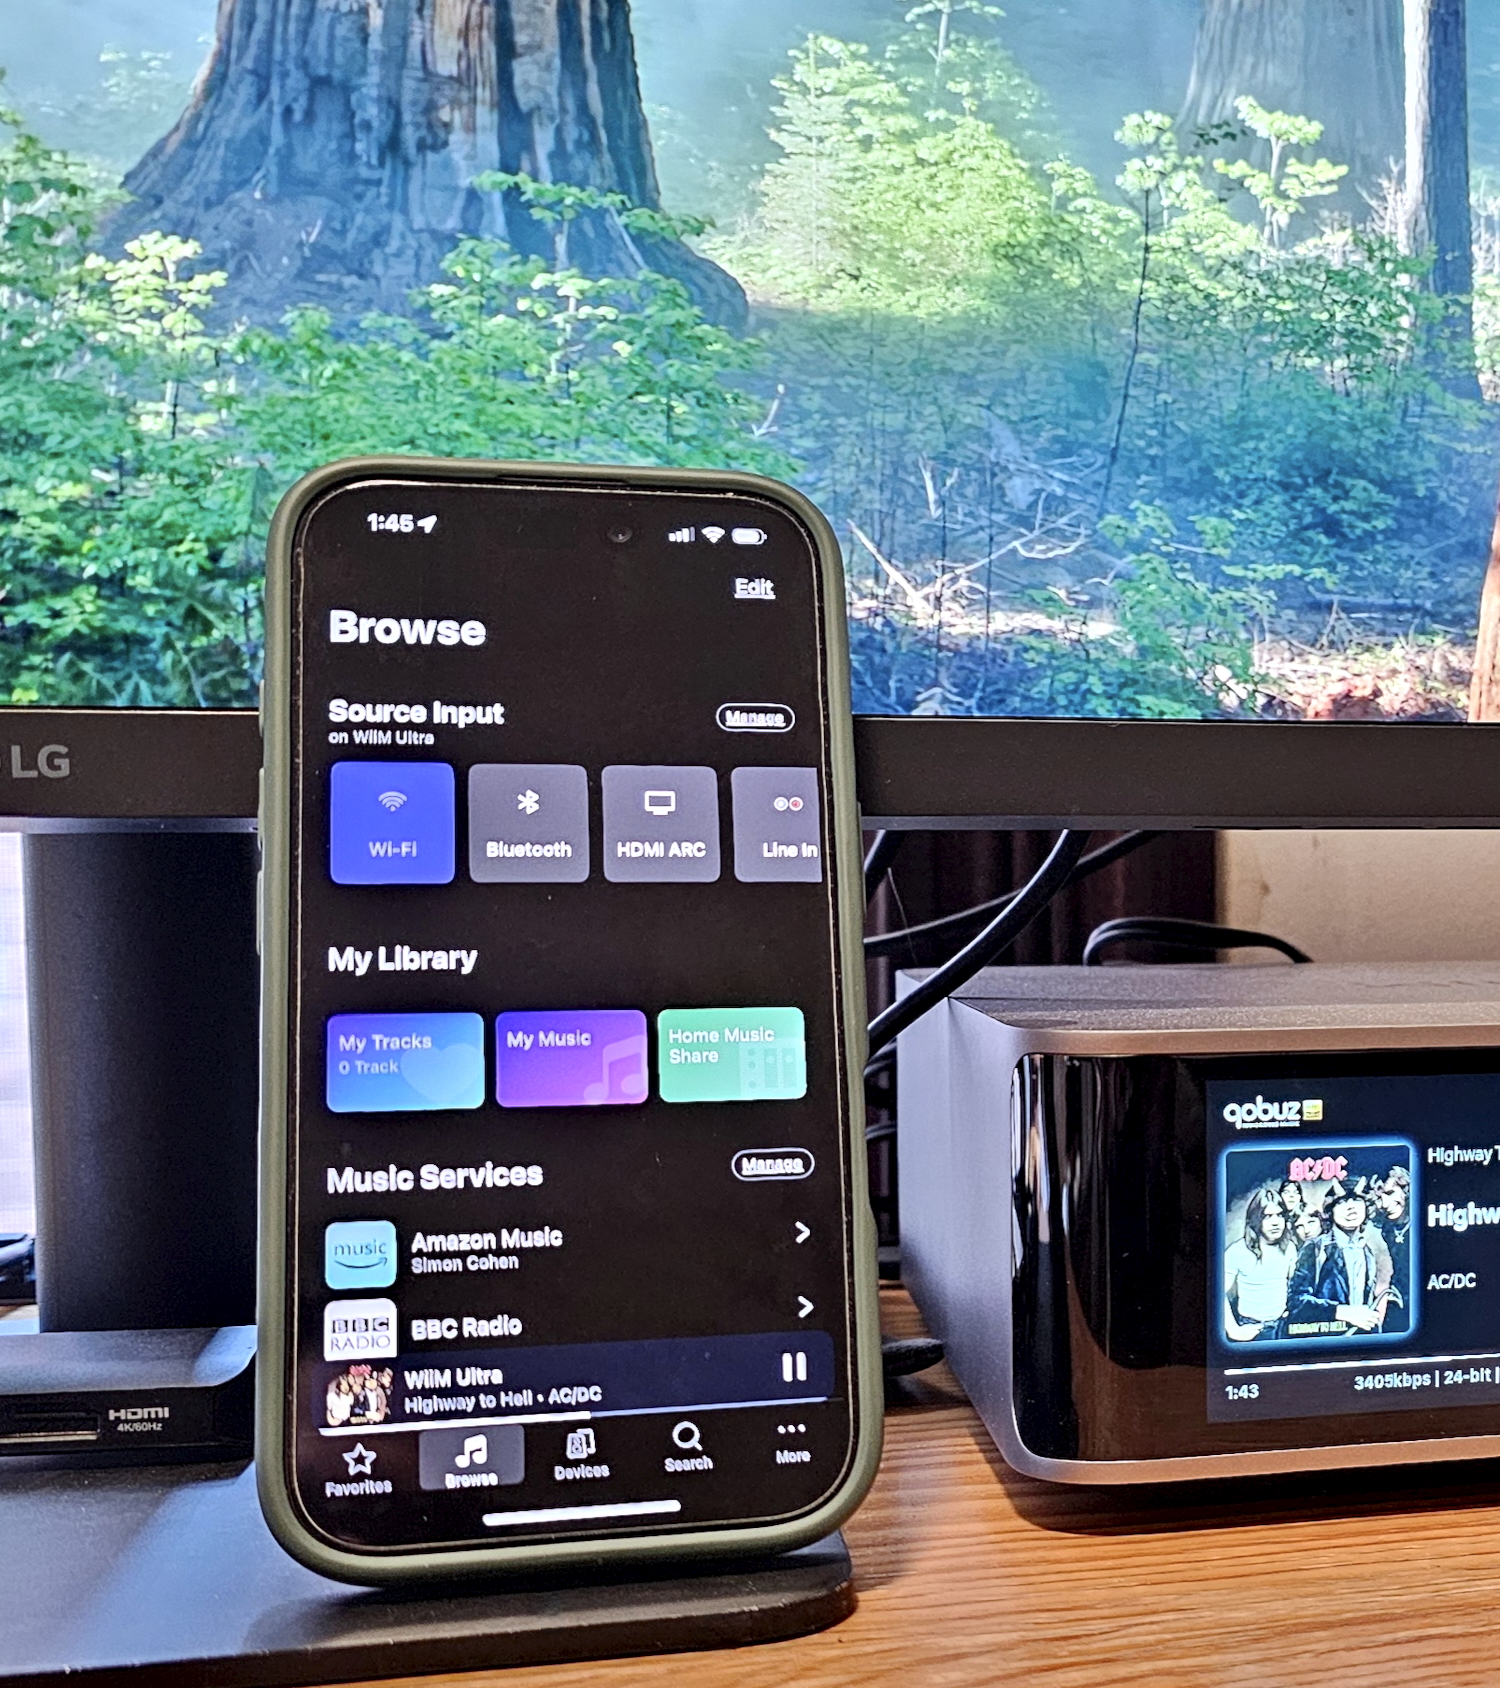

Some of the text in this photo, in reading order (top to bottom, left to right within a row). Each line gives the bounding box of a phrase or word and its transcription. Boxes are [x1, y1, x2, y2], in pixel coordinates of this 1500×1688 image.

[367, 513, 414, 533] 1:45
[735, 577, 775, 598] Edit
[329, 609, 487, 646] Browse
[329, 699, 506, 727] Source Input
[725, 709, 787, 728] Manage
[329, 729, 435, 746] on WiiM Ultra
[11, 744, 71, 778] LG
[368, 841, 417, 858] Wi-Fi
[486, 841, 572, 858] Bluetooth
[617, 842, 707, 858] HDMI ARC
[763, 841, 818, 858] Line In
[328, 945, 478, 976] My Library
[338, 1032, 432, 1054] My Tracks
[506, 1029, 592, 1050] My Music
[668, 1026, 775, 1045] Home Music
[669, 1048, 719, 1065] Share
[338, 1058, 400, 1075] 0 Track
[1223, 1095, 1301, 1129] qobuz
[1427, 1145, 1493, 1165] Highway
[741, 1157, 805, 1176] Manage
[327, 1162, 544, 1195] Music Services
[334, 1239, 387, 1257] music
[411, 1226, 563, 1253] Amazon Music
[411, 1253, 519, 1273] Simon Cohen
[1427, 1272, 1476, 1291] AC/DC
[333, 1317, 390, 1333] BBC
[411, 1315, 522, 1340] BBC Radio
[331, 1335, 391, 1352] RADIO
[404, 1366, 503, 1389] WiiM Ultra
[1354, 1372, 1431, 1391] 3405kbps
[1444, 1366, 1491, 1385] 24-bit
[404, 1394, 474, 1415] Highway
[480, 1392, 497, 1408] to
[501, 1390, 533, 1408] Hell
[547, 1386, 603, 1404] AC/DC
[1225, 1384, 1259, 1400] 1:43
[108, 1407, 169, 1421] HDMI
[117, 1422, 163, 1432] 4K/60Hz
[664, 1454, 713, 1473] Search
[775, 1447, 811, 1465] More
[444, 1470, 499, 1488] Browse
[554, 1462, 610, 1481] Devices
[325, 1478, 393, 1498] Favorites
